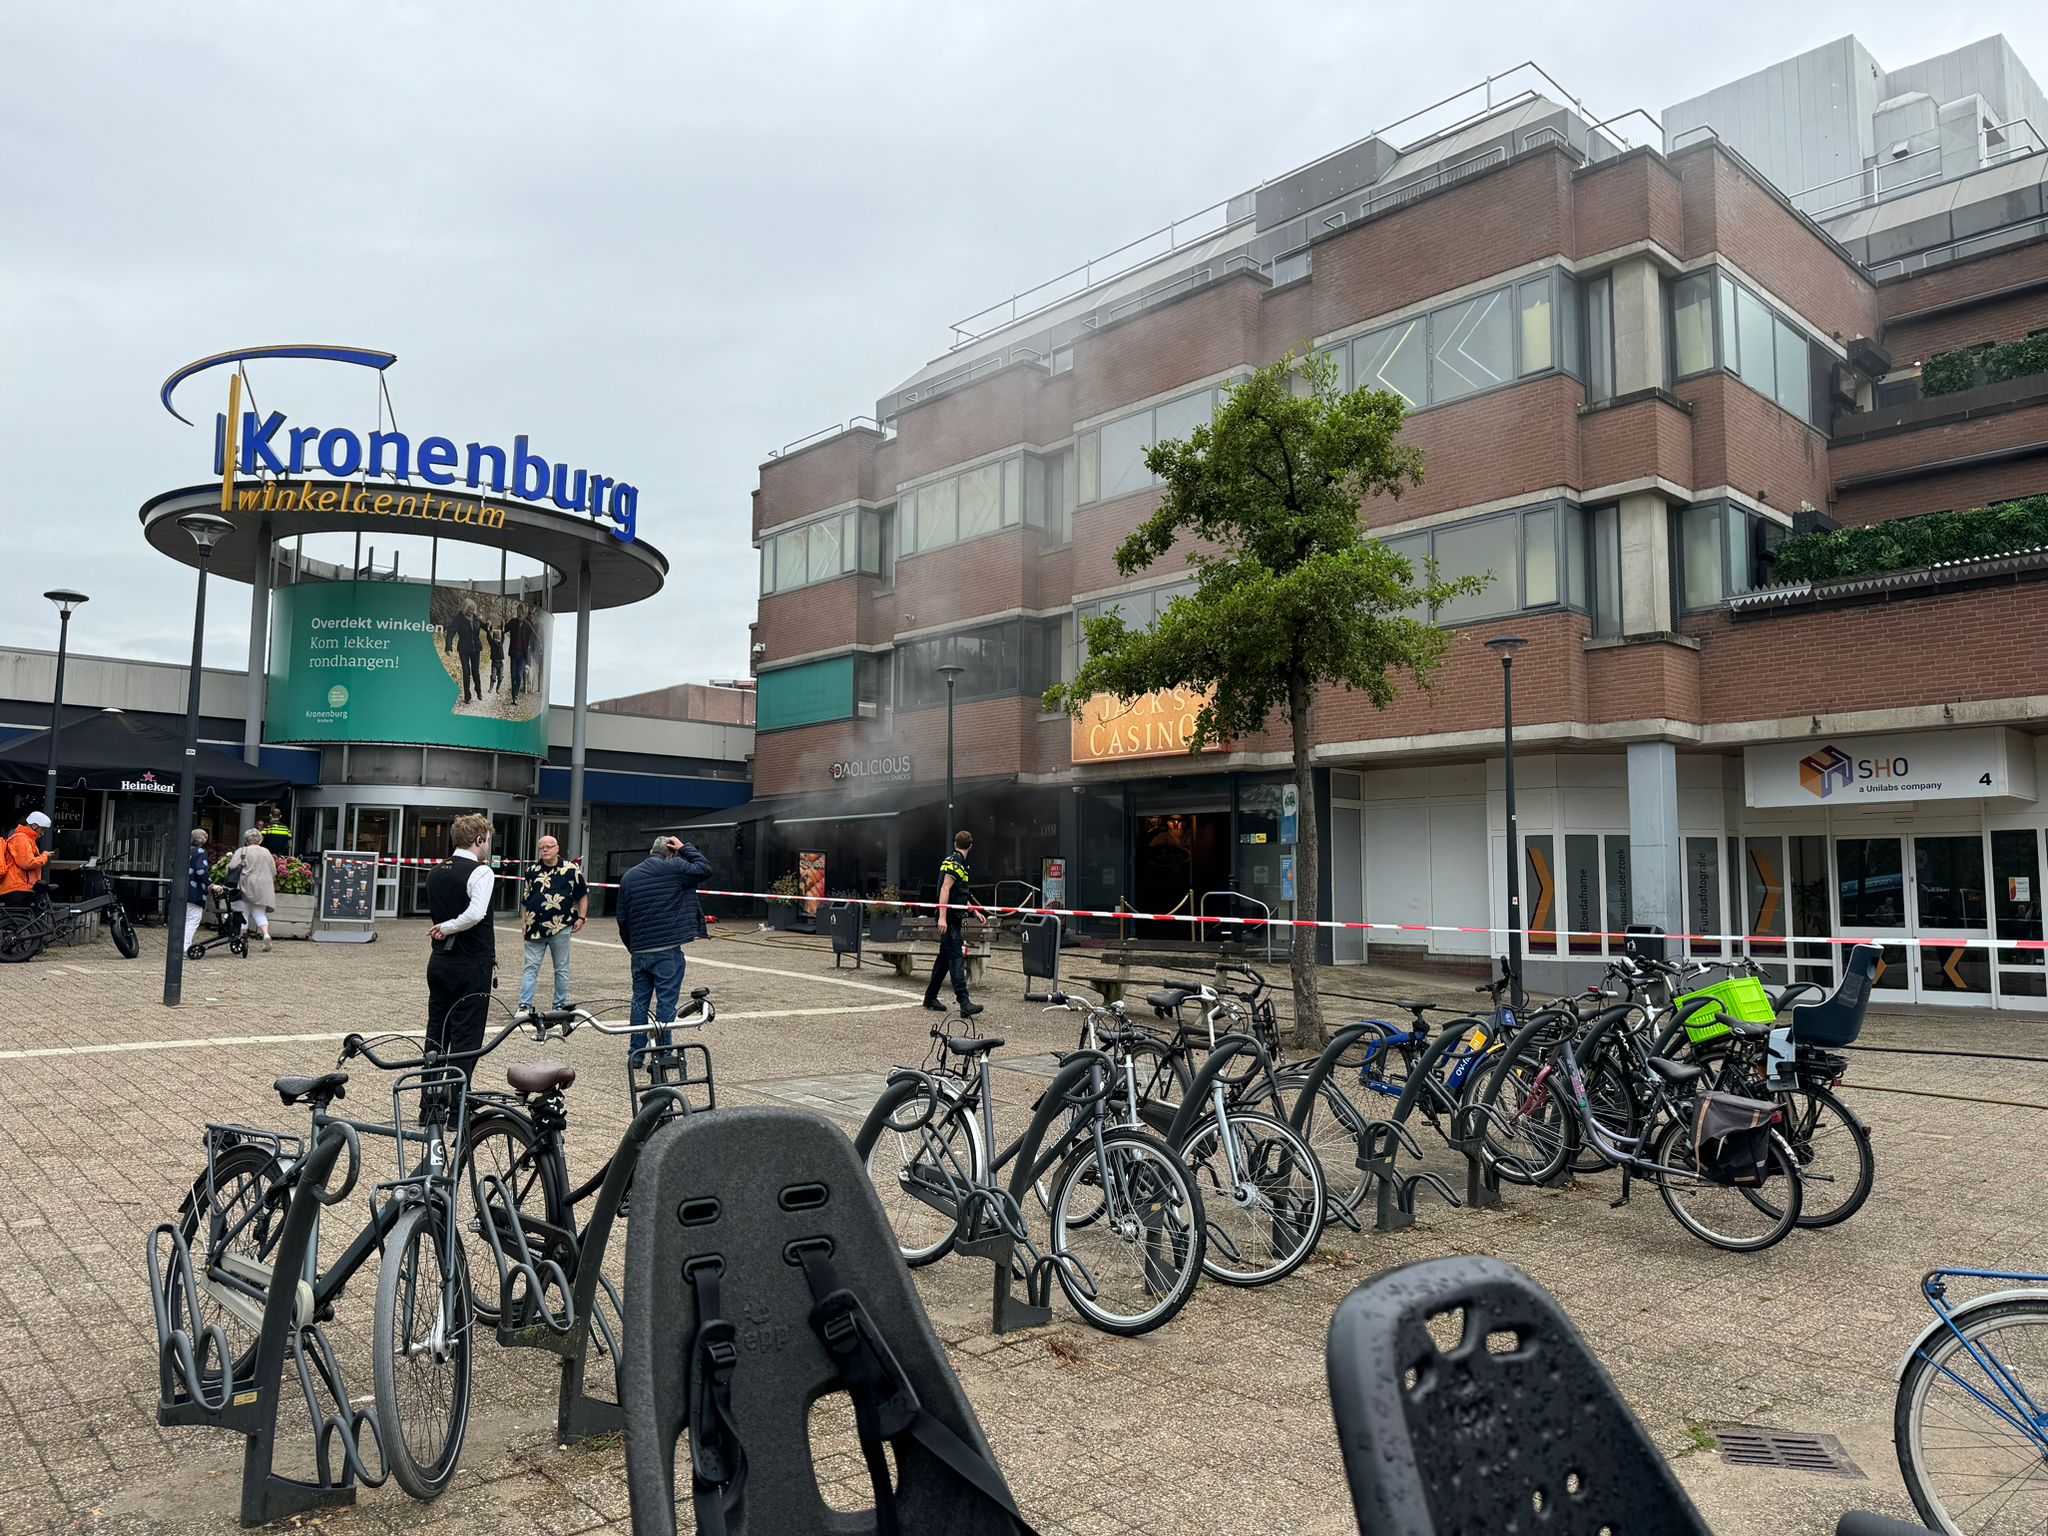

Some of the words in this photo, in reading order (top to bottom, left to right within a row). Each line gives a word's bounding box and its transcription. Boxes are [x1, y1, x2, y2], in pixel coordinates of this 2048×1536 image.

[243, 410, 639, 543] Kronenburg
[238, 481, 506, 529] winkelcentrum
[311, 617, 372, 629] Overdekt
[310, 637, 339, 649] Kom
[344, 636, 390, 649] lekker
[309, 655, 399, 670] rondhangen!
[305, 710, 348, 719] Kronenburg
[1090, 713, 1198, 756] CASINO
[1858, 757, 1909, 779] SHO
[1978, 772, 1992, 786] 4
[121, 781, 174, 793] Heineken
[1866, 784, 1899, 793] Unilabs
[1901, 781, 1942, 792] company
[54, 810, 81, 821] ntrée
[1616, 848, 1627, 932] Functieonderzoek
[1699, 853, 1710, 932] Fundusfotografie
[1579, 868, 1589, 931] Bloedafname
